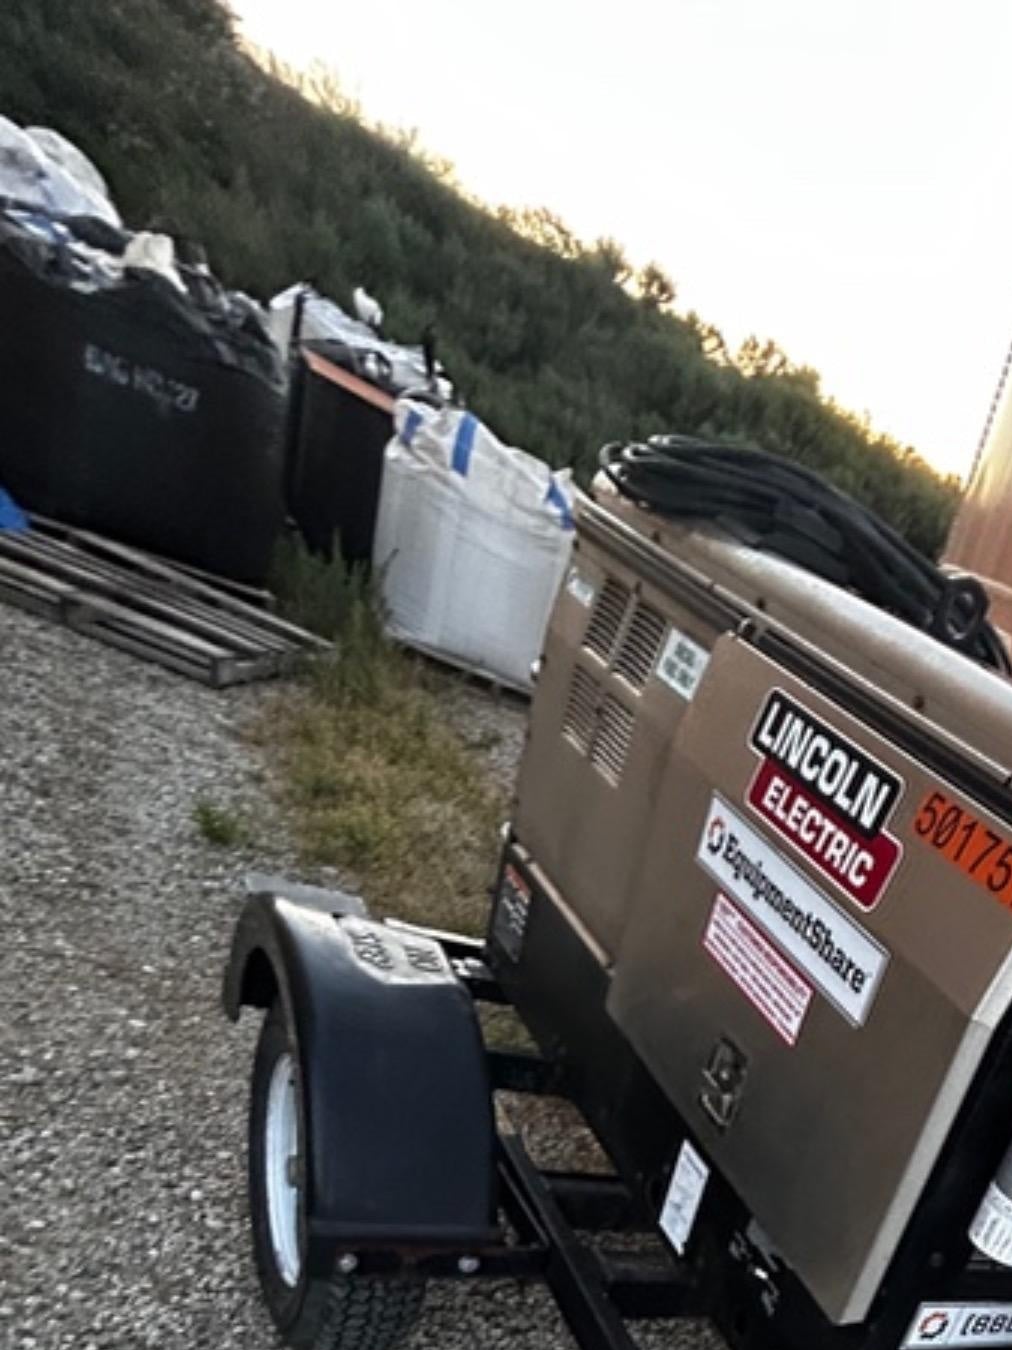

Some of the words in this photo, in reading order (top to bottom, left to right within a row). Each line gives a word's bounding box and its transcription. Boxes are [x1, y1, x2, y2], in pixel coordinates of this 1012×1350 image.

[758, 702, 891, 826] LINCOLN
[764, 782, 875, 889] ELECTRIC
[722, 833, 867, 995] EquipmentShare
